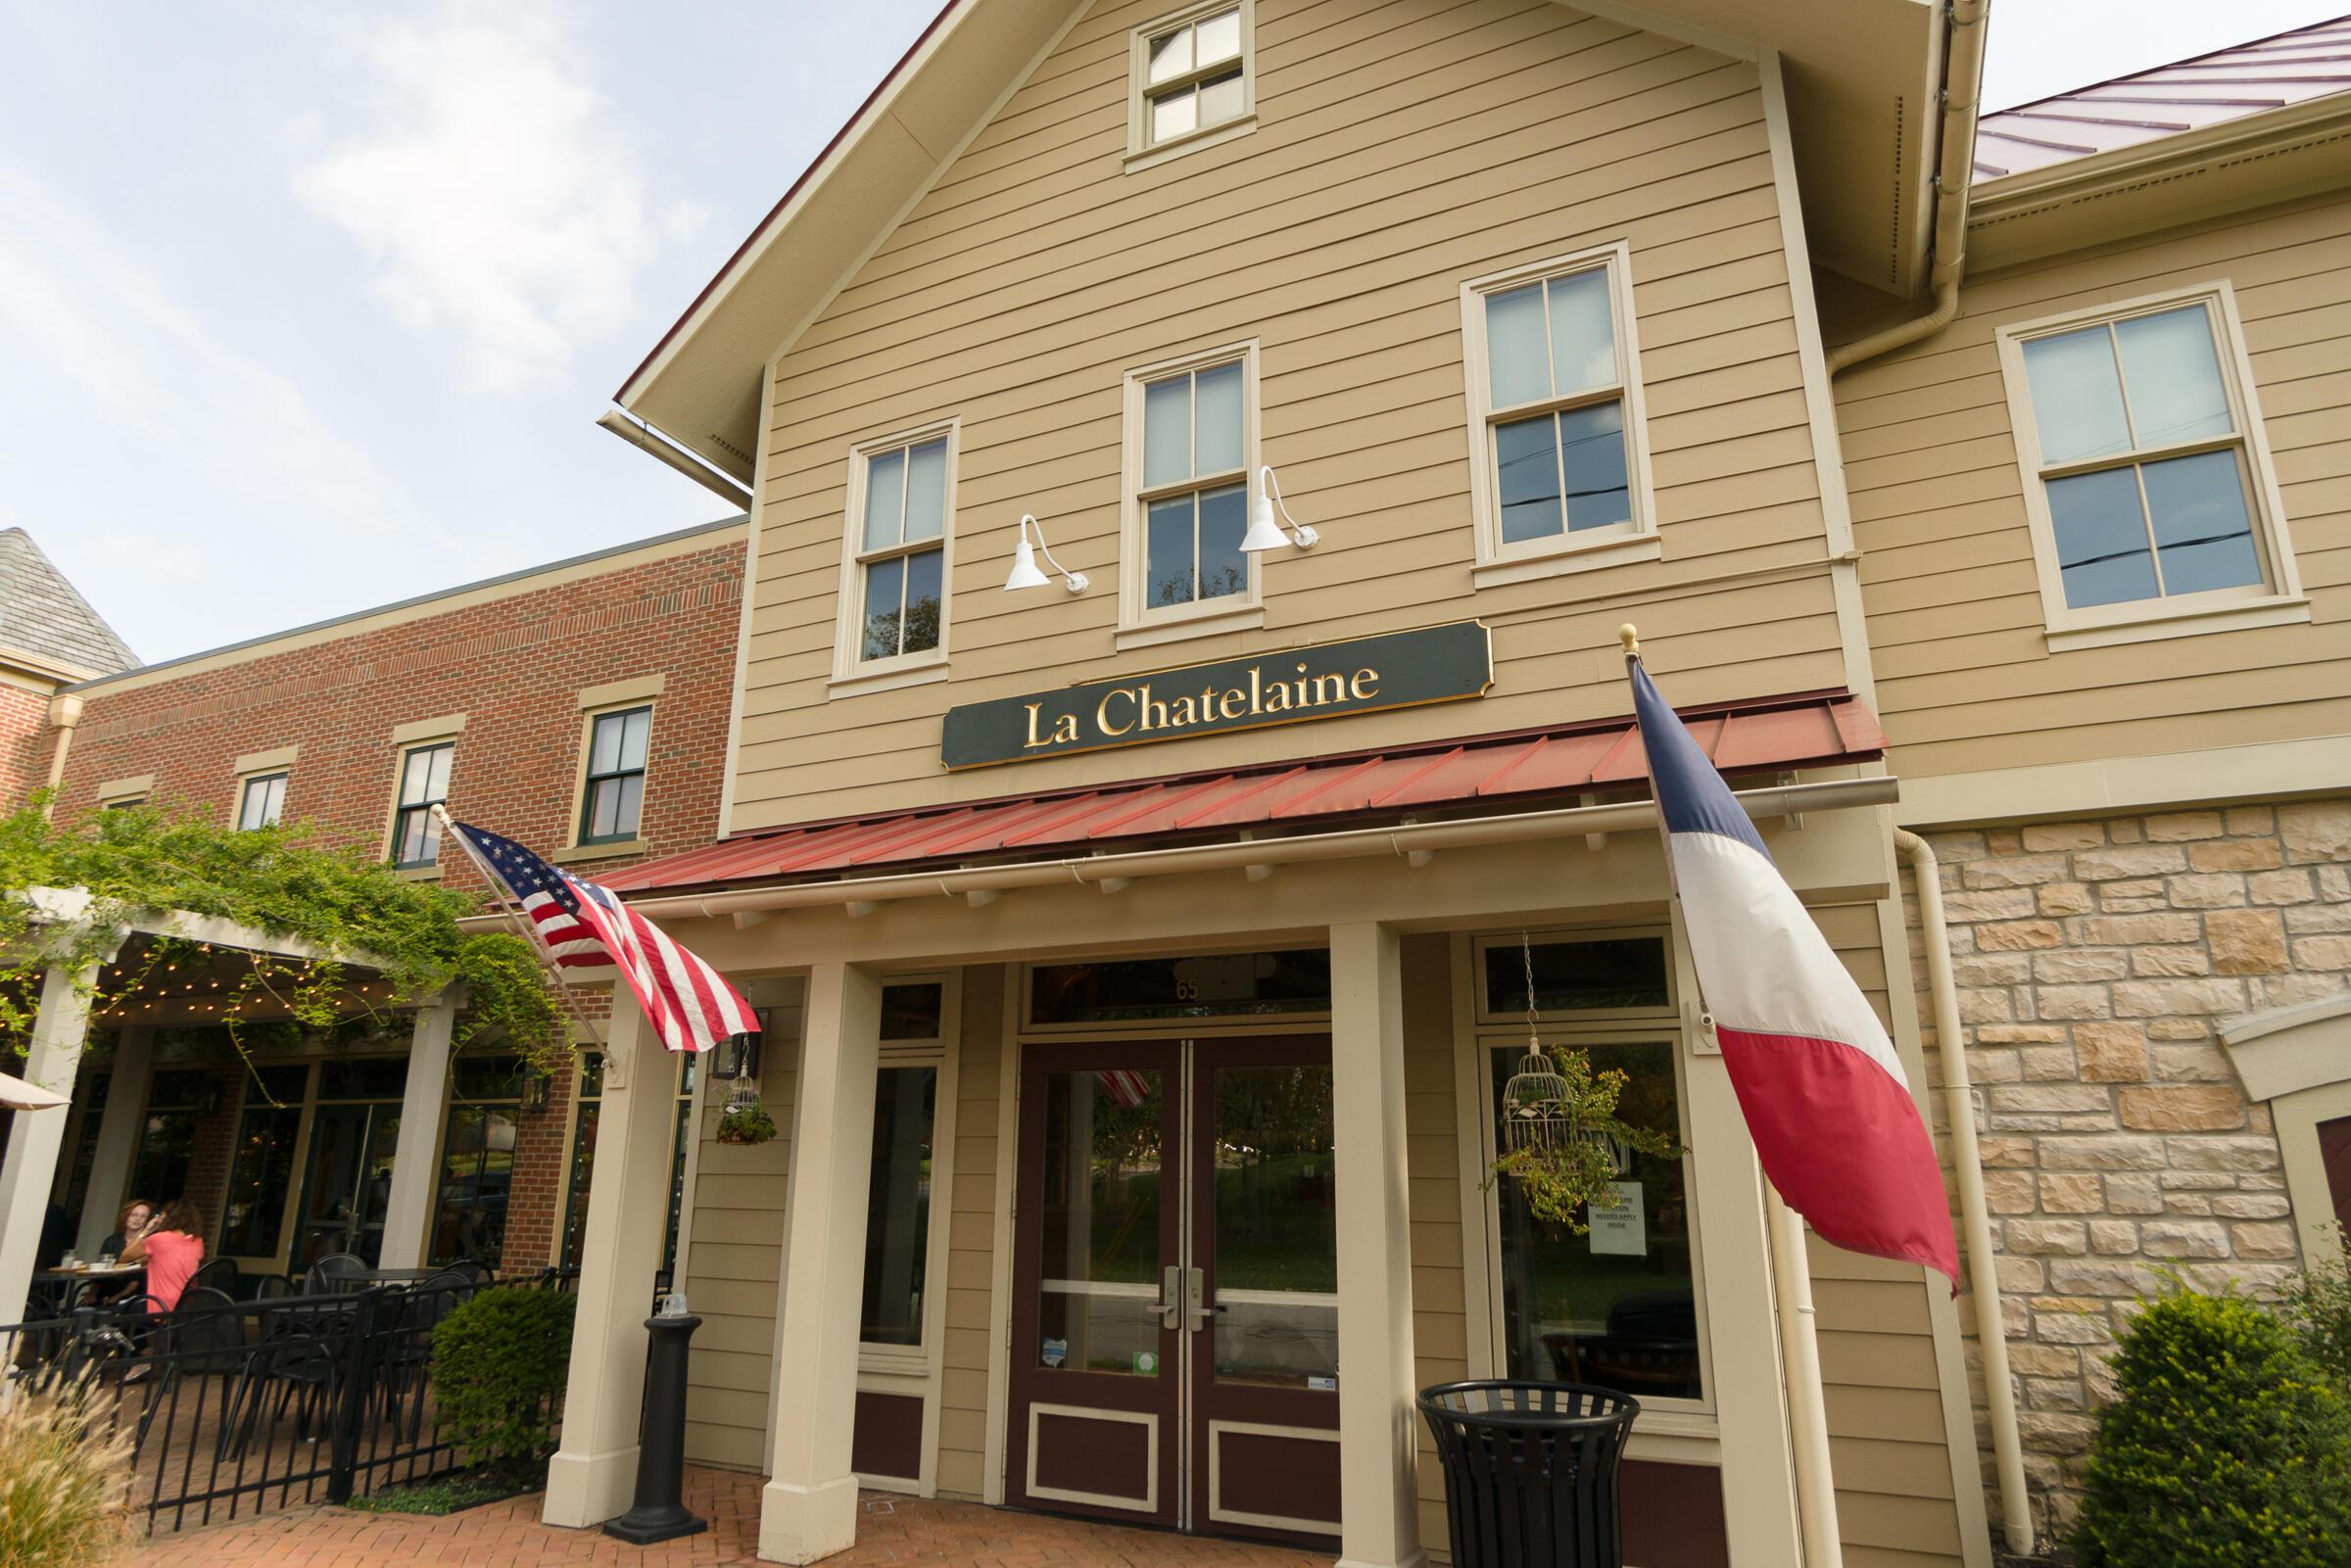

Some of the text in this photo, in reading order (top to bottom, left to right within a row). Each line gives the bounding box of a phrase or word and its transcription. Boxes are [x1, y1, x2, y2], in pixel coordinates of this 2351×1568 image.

[1024, 662, 1379, 748] La Chatelaine
[1176, 978, 1198, 999] 65
